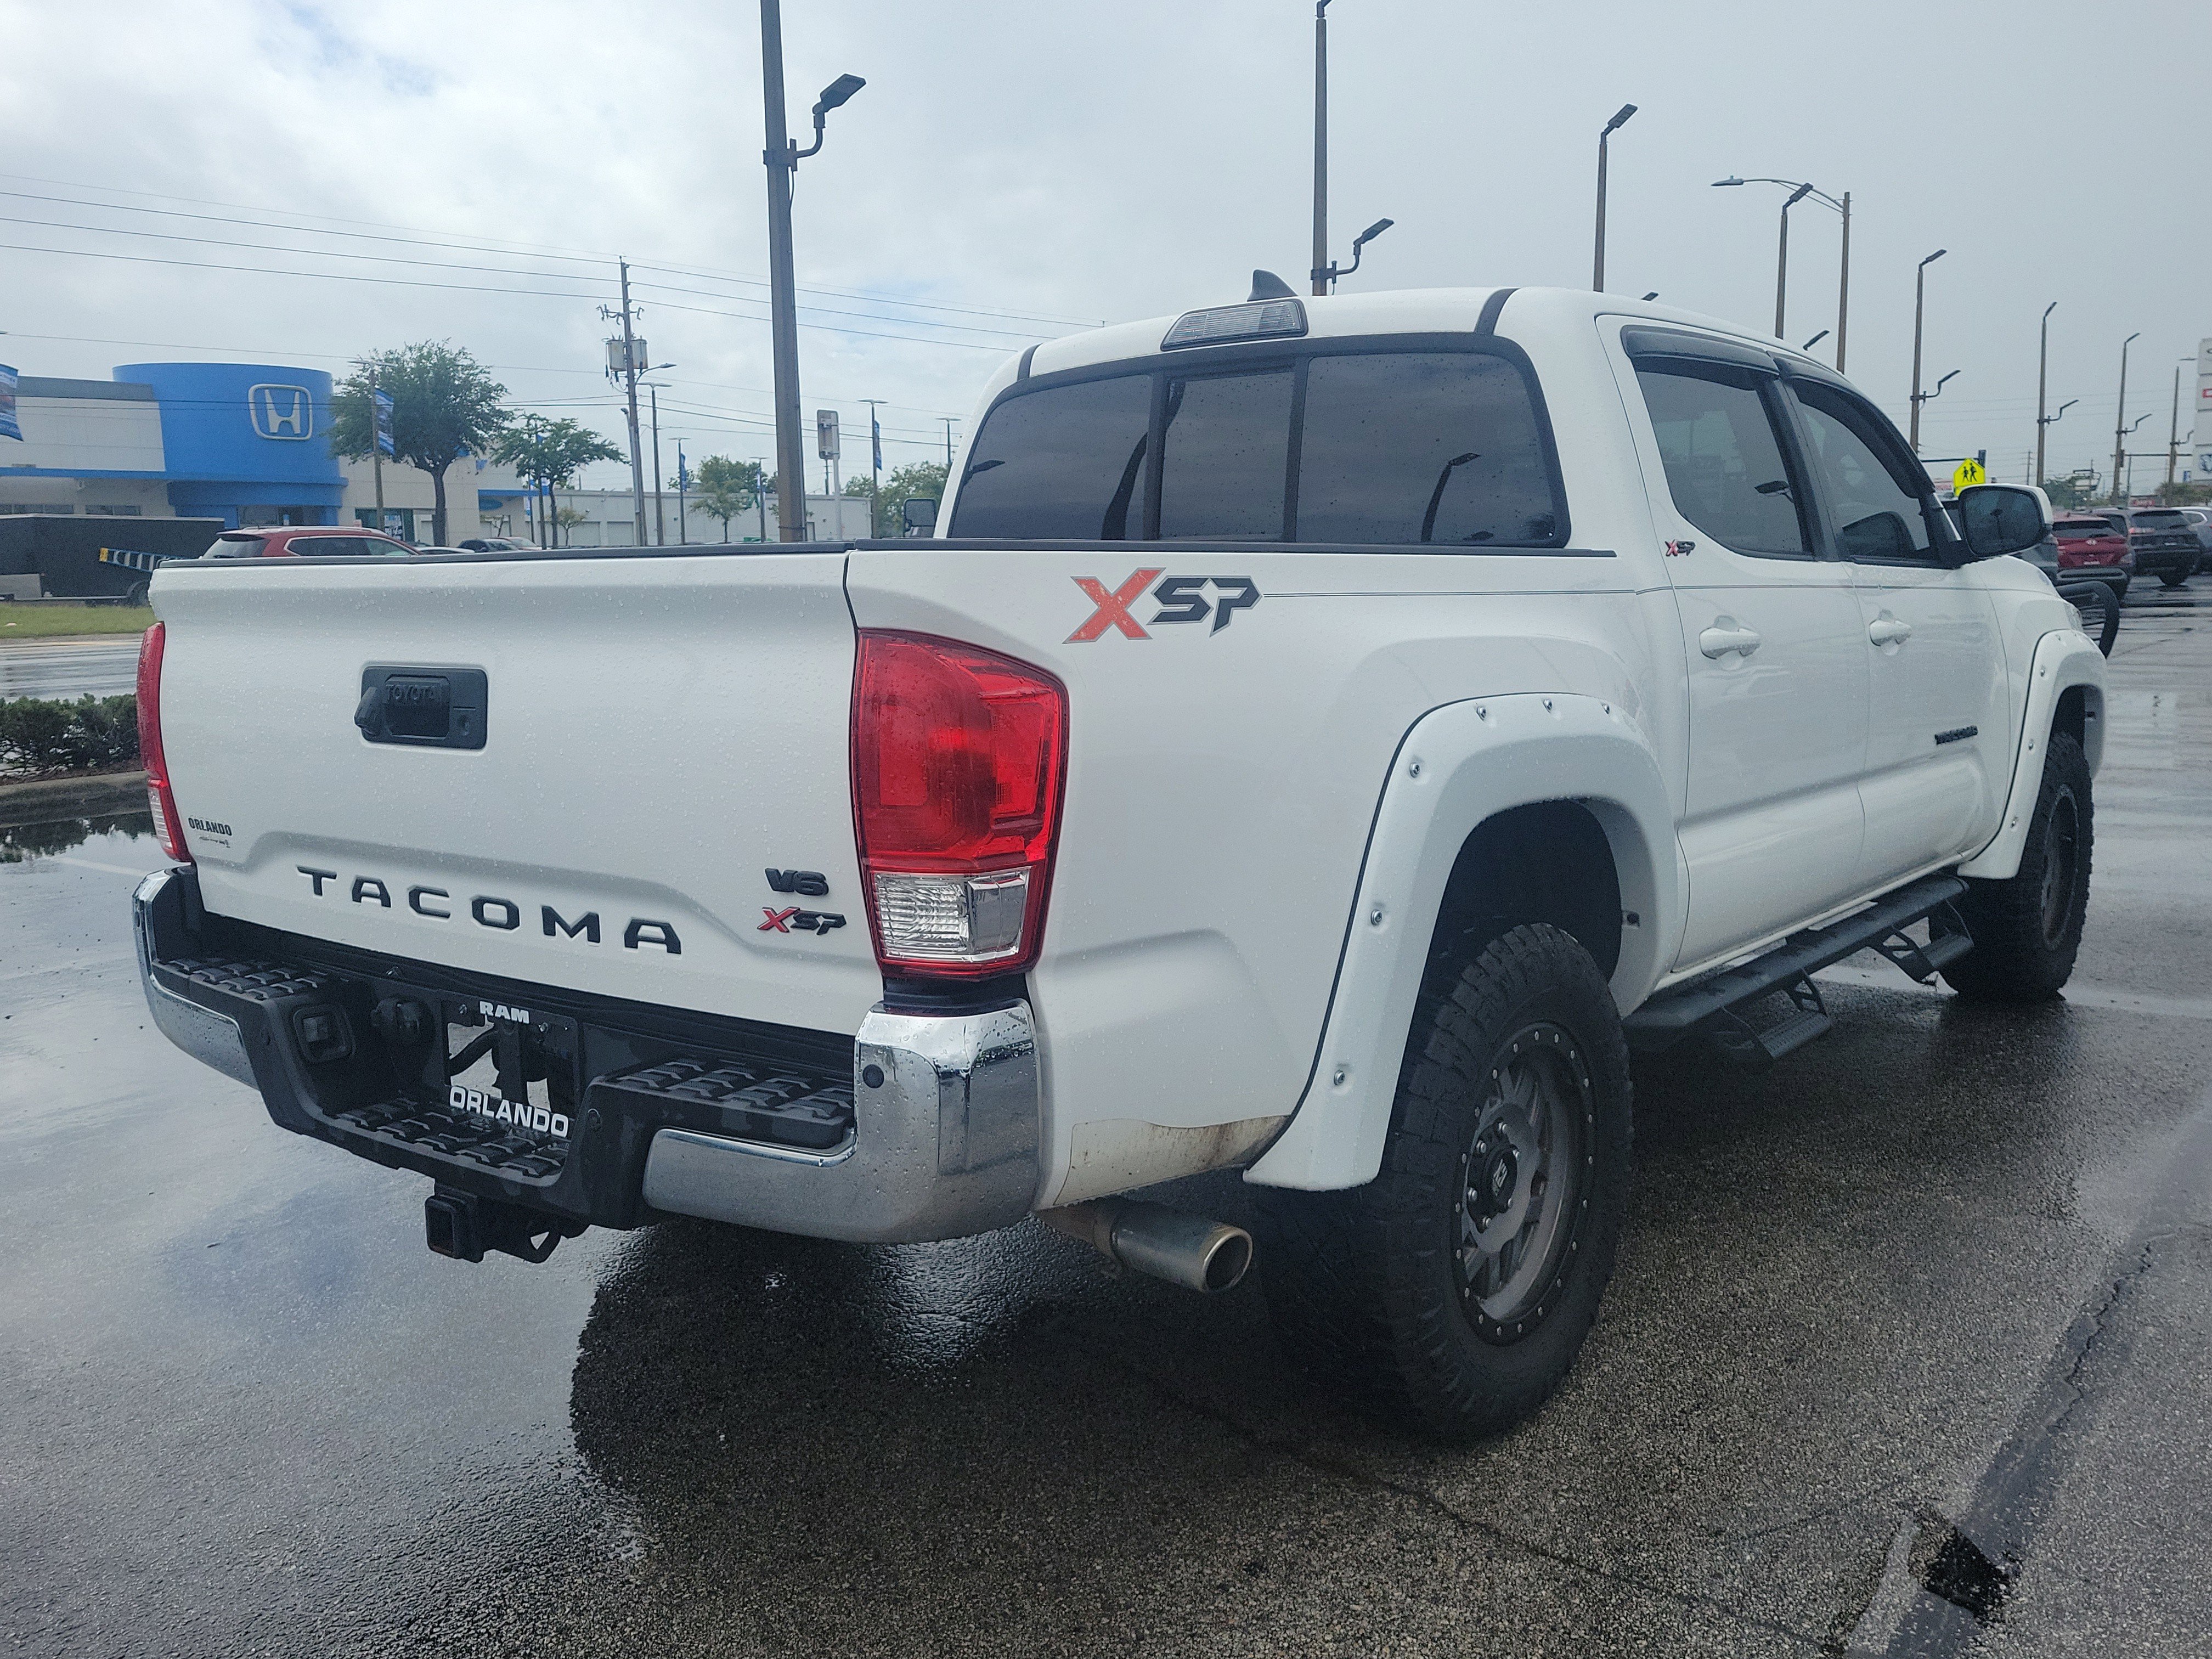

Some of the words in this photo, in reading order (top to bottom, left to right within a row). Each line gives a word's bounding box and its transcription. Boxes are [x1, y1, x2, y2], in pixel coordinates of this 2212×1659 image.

[1062, 567, 1263, 644] XSP
[188, 817, 232, 836] ORLANDO
[765, 868, 829, 895] V6
[297, 866, 681, 955] TACOMA
[757, 906, 847, 935] XSP
[479, 1001, 529, 1024] RAM
[450, 1086, 569, 1138] ORLANDO
